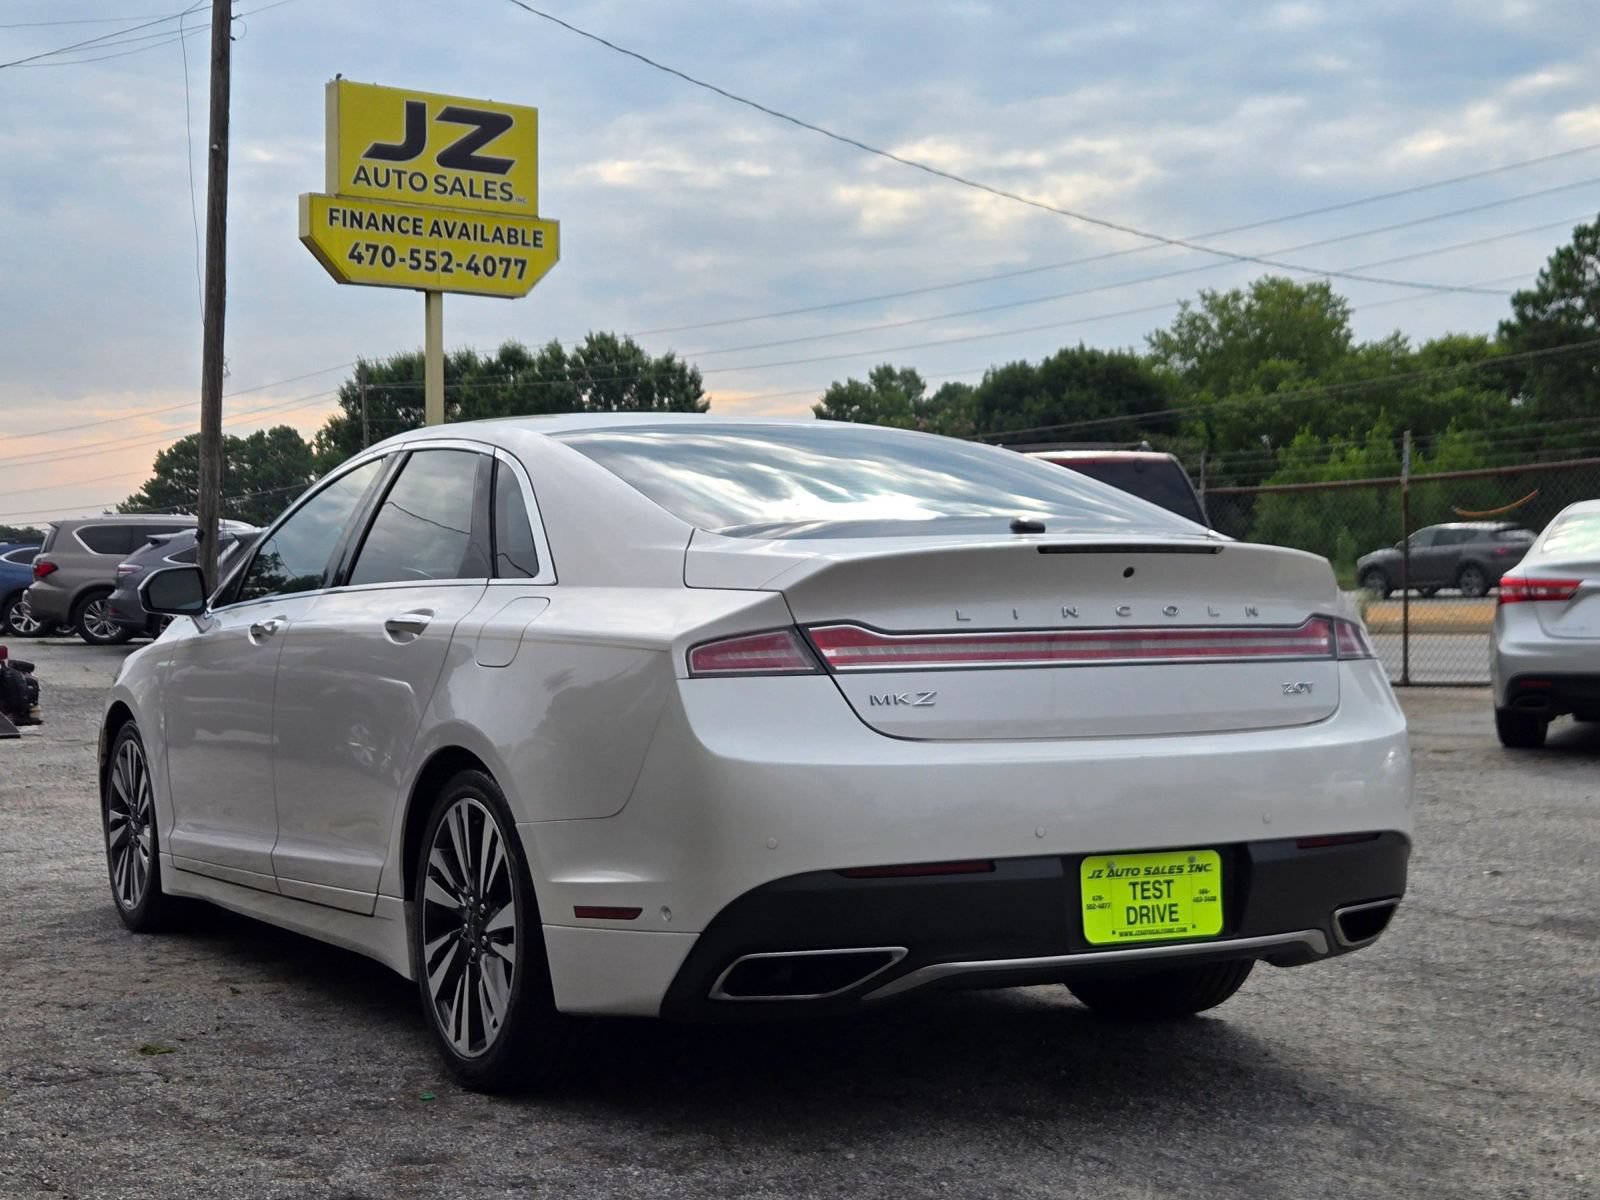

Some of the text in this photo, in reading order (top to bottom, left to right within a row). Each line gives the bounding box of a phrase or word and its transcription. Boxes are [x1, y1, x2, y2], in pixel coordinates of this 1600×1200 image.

[362, 100, 516, 176] JZ
[352, 165, 428, 193] AUTO
[434, 174, 514, 202] SALES
[328, 207, 544, 248] FINANCE AVAILABLE
[348, 242, 528, 280] 470-552-4077
[955, 606, 1259, 622] LINCOLN
[869, 690, 937, 707] MKZ
[1088, 869, 1105, 879] JZ
[1106, 867, 1140, 878] AUTO
[1143, 864, 1185, 876] SALES
[1128, 879, 1174, 900] TEST
[1126, 903, 1179, 925] DRIVE
